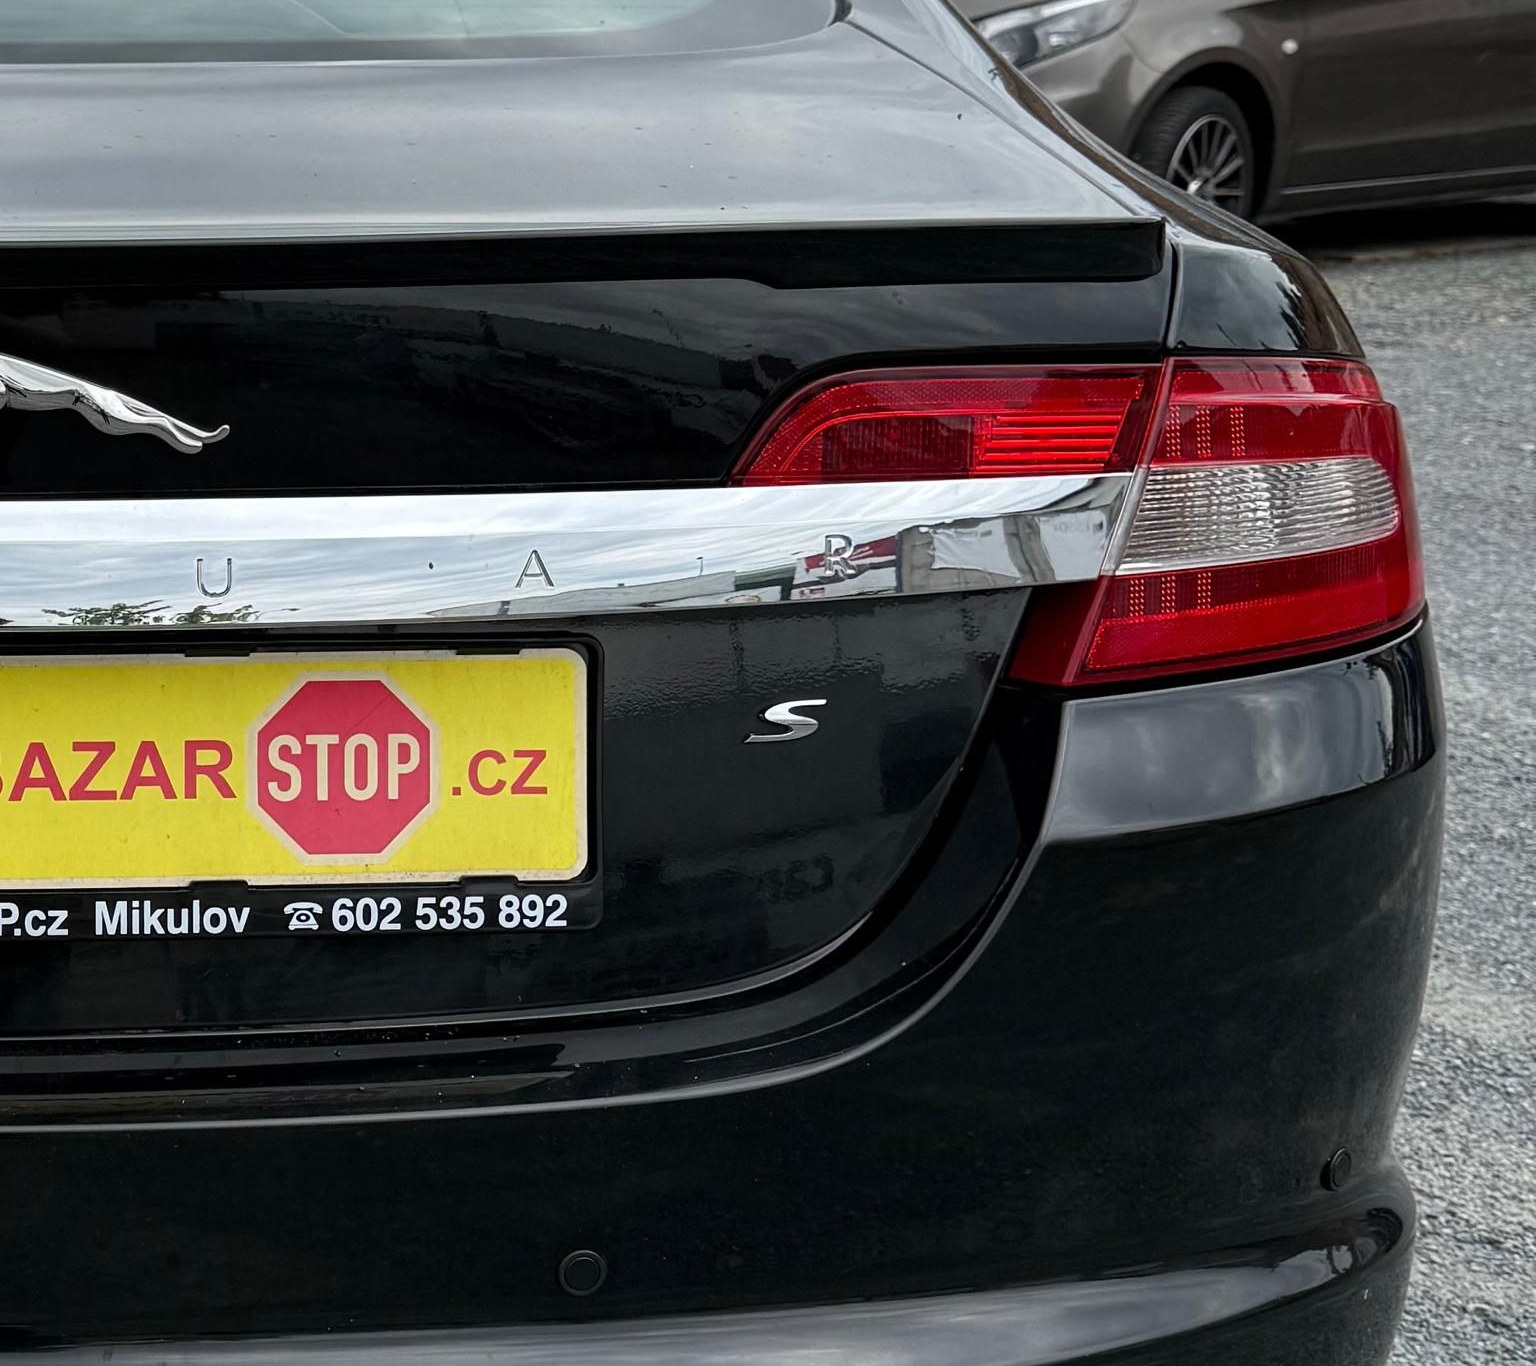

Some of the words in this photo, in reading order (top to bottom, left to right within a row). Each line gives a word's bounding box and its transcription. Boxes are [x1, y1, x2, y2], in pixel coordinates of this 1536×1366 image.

[744, 698, 828, 743] S
[267, 732, 421, 802] STOP
[95, 899, 251, 935] Mikulov
[331, 896, 402, 932] 602
[415, 895, 485, 931] 535
[498, 893, 568, 929] 892
